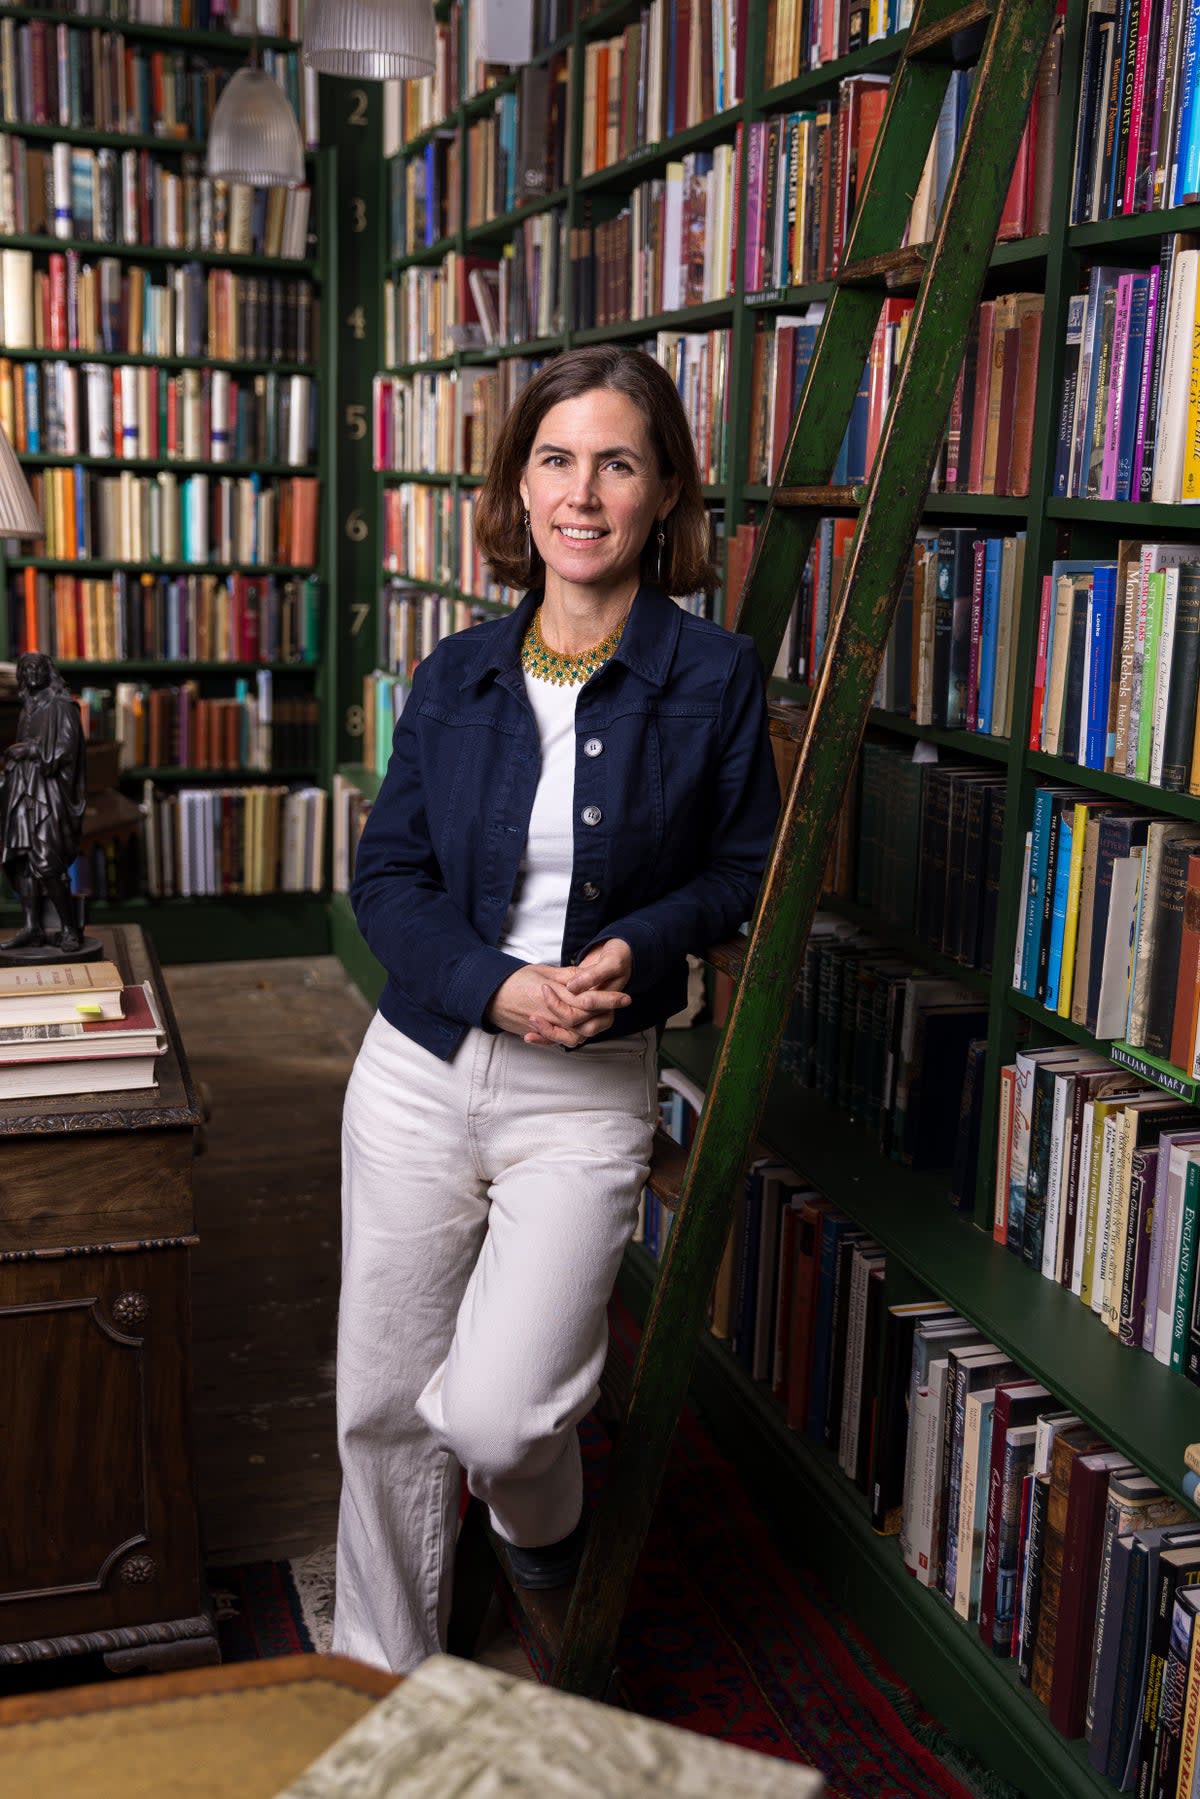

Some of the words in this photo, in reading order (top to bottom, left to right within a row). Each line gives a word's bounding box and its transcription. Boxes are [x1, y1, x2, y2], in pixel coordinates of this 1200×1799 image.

[1128, 10, 1139, 66] STUART
[1166, 36, 1174, 69] Scotland
[1110, 58, 1121, 101] Refiguring
[1162, 77, 1171, 112] Buckroyd
[1183, 52, 1197, 108] BULLETS
[347, 90, 368, 127] 2
[1122, 72, 1132, 135] COURTS
[1106, 107, 1118, 157] Revolutions
[353, 198, 367, 233] 3
[346, 306, 367, 339] 4
[1063, 378, 1071, 404] JOHN
[1068, 391, 1076, 424] POPISH
[1150, 368, 1160, 421] REPRESENTATION
[345, 405, 368, 440] 5
[1060, 404, 1069, 440] KENYON
[345, 508, 369, 541] 6
[976, 550, 984, 566] SO
[974, 570, 984, 594] IDLE
[1139, 552, 1153, 617] SEDGEMOOR
[1166, 575, 1175, 589] The
[349, 604, 370, 636] 7
[972, 606, 982, 644] ROGUE
[1121, 570, 1140, 651] Monmouth's
[1143, 582, 1157, 663] SEDGEMOOR
[1164, 592, 1173, 627] Western
[1138, 620, 1146, 641] 1685
[1160, 632, 1170, 658] Rising
[1119, 655, 1134, 698] Rebels
[1158, 662, 1168, 696] Charles
[346, 705, 365, 736] 8
[1118, 704, 1127, 726] Peter
[1155, 698, 1164, 737] Chenevix
[1116, 728, 1126, 750] Earle
[1153, 742, 1161, 771] Trench
[1036, 798, 1044, 826] KING
[1034, 829, 1041, 842] IN
[1048, 831, 1056, 866] STUARTS'
[1032, 845, 1040, 874] EXILE
[1143, 856, 1152, 901] WILLIAM
[1028, 899, 1036, 926] JAMES
[1110, 1047, 1147, 1075] WILLIAM
[1158, 1073, 1185, 1096] MARY
[1013, 1065, 1032, 1150] Revolution
[1050, 1136, 1060, 1178] ABSOLUTE
[1120, 1131, 1131, 1170] Kingdom
[1091, 1176, 1097, 1184] of
[1112, 1158, 1121, 1214] REVOLUTION
[1118, 1172, 1126, 1206] without
[1131, 1180, 1139, 1197] The
[1048, 1178, 1057, 1224] MONARCHY
[1089, 1186, 1097, 1216] William
[1128, 1198, 1138, 1234] Glorious
[1086, 1236, 1094, 1254] Mary
[1115, 1218, 1123, 1242] King
[1180, 1206, 1195, 1272] ENGLAND
[1100, 1242, 1110, 1280] England
[1124, 1236, 1135, 1281] Revolution
[1122, 1282, 1130, 1293] of
[1178, 1286, 1186, 1302] the
[1179, 1274, 1187, 1284] in
[1173, 1304, 1186, 1338] 1690s
[948, 1366, 956, 1382] The
[956, 1371, 966, 1410] Grand
[944, 1406, 953, 1443] Conquest
[954, 1410, 964, 1438] Tour
[1004, 1448, 1013, 1482] Creative
[1002, 1483, 1010, 1521] Quarters
[988, 1518, 996, 1538] the
[1106, 1530, 1114, 1552] THE
[1100, 1557, 1111, 1616] VICTORIAN
[1159, 1576, 1168, 1618] BRACEGIRDLE
[1096, 1618, 1105, 1655] VISION
[1148, 1654, 1157, 1686] Industrial
[1143, 1687, 1154, 1724] Revolution
[1151, 1669, 1162, 1712] Archaeology
[1170, 1661, 1186, 1740] BRITAIN'S
[1150, 1713, 1156, 1721] of
[1183, 1674, 1200, 1767] VICTORIAN
